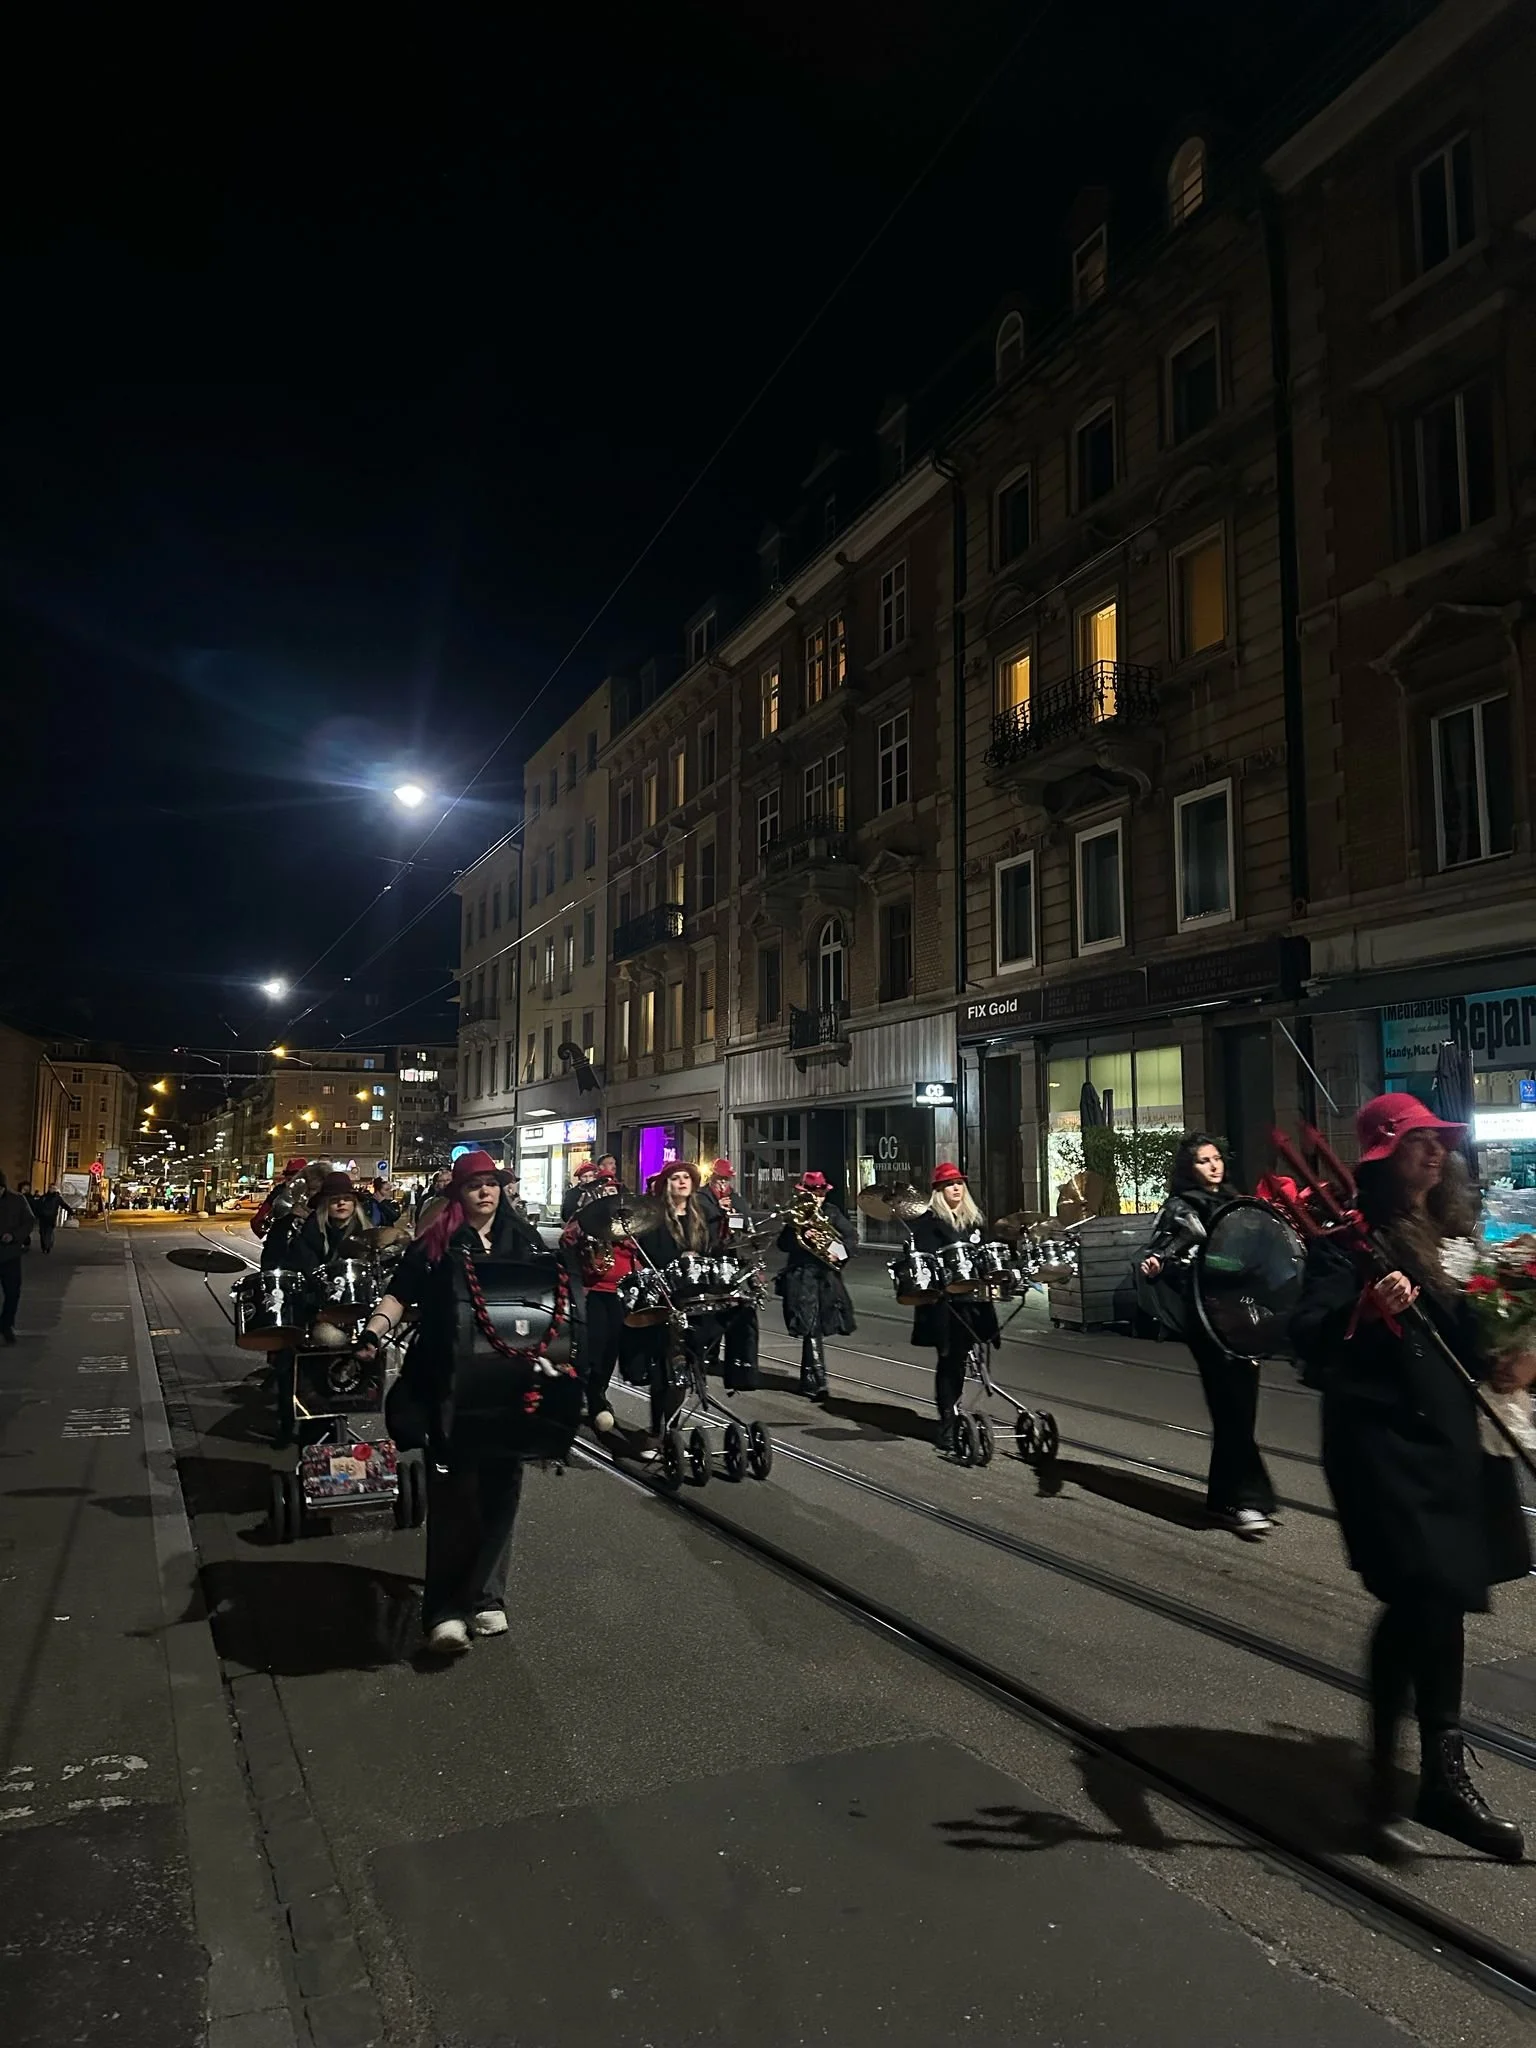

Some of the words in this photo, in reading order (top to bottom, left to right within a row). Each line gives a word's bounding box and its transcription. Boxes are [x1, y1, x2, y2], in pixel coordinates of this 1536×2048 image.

[966, 1004, 987, 1019] FIX
[988, 998, 1019, 1016] Gold
[925, 1083, 945, 1097] CG
[878, 1135, 898, 1160] CG
